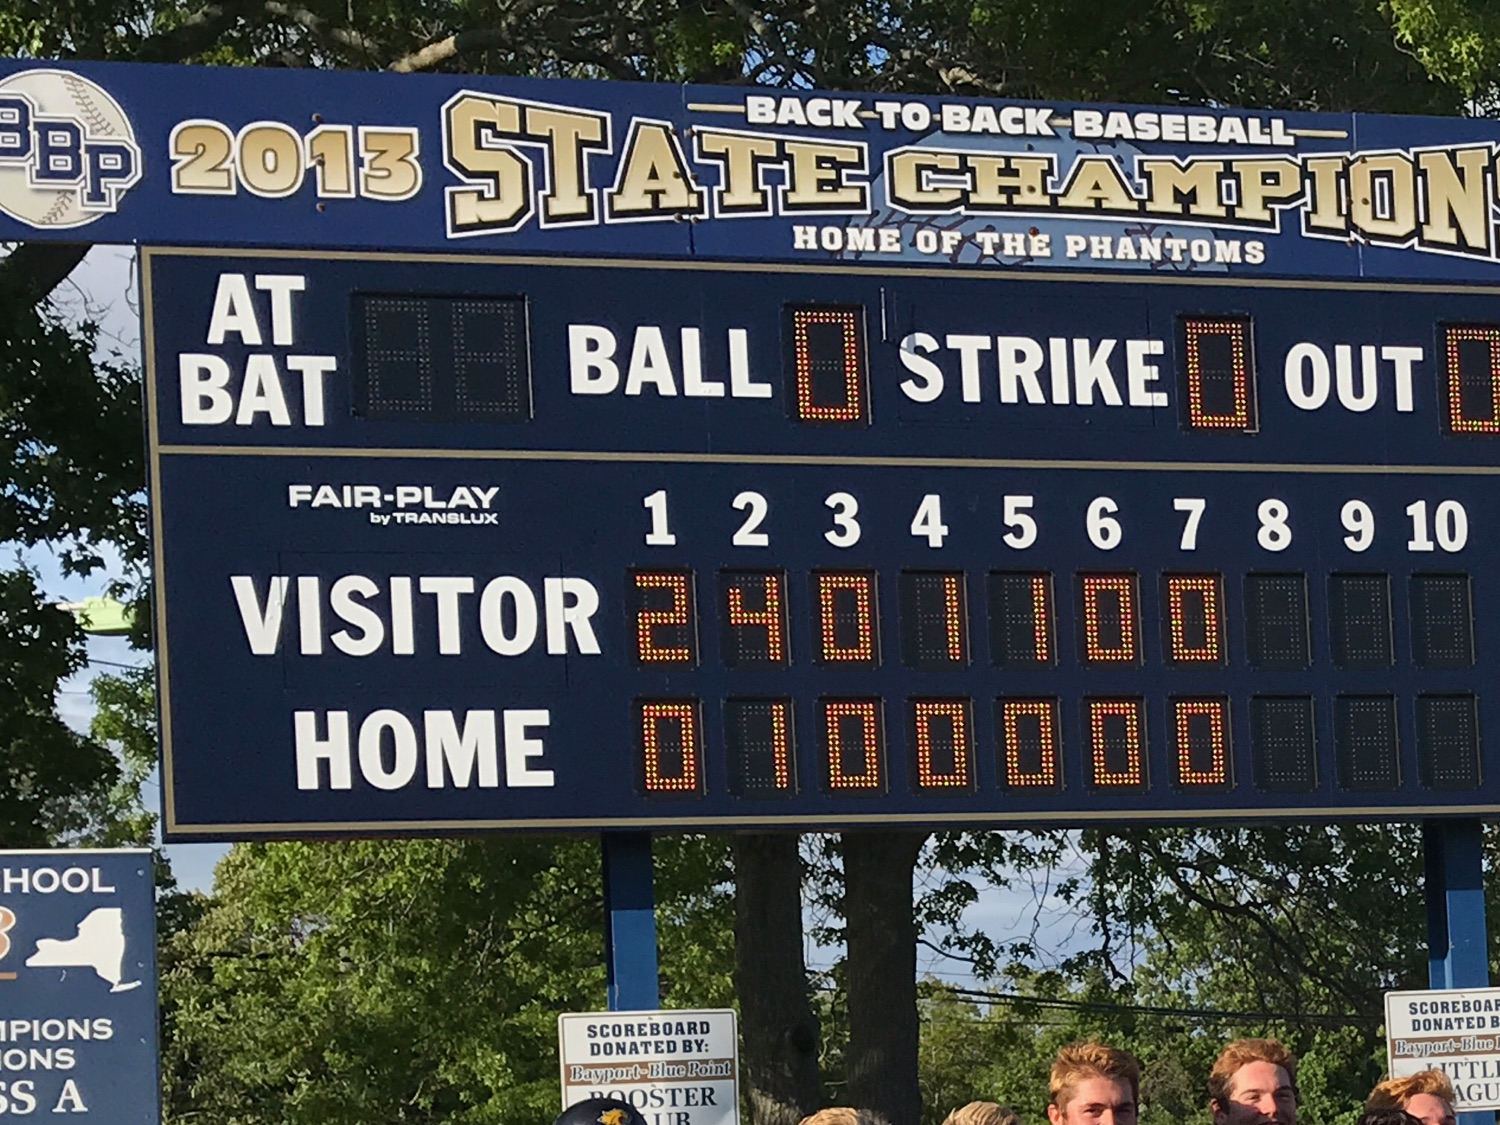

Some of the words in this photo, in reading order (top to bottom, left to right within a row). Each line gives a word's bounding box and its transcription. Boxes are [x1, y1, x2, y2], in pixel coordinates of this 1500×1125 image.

[747, 96, 863, 128] BACK
[876, 101, 923, 132] TO
[942, 105, 1052, 136] BACK
[1074, 111, 1294, 146] BASEBALL
[169, 120, 422, 200] 2013
[441, 90, 870, 239] STATE
[793, 225, 901, 253] HOME
[916, 229, 960, 255] OF
[975, 231, 1051, 258] THE
[1065, 234, 1266, 265] PHANTOMS
[206, 273, 305, 345] AT
[567, 325, 773, 399] BALL
[793, 310, 861, 421] 0
[899, 332, 1168, 408] STRIKE
[1185, 320, 1248, 429] 0
[1284, 342, 1424, 413] OUT
[179, 353, 337, 426] BAT
[288, 485, 500, 510] FAIR-PLAY
[392, 511, 499, 526] TRANSLUX
[643, 490, 677, 545] 1
[731, 491, 769, 547] 2
[823, 491, 861, 548] 3
[910, 494, 949, 548] 4
[1002, 495, 1037, 549] 5
[1086, 496, 1122, 550] 6
[1173, 498, 1206, 550] 7
[1256, 498, 1292, 552] 8
[1340, 499, 1375, 553] 9
[1406, 500, 1469, 553] 10
[230, 575, 601, 656] VISITOR
[634, 574, 690, 662] 2
[727, 576, 782, 663] 4
[819, 576, 873, 662] 0
[944, 576, 961, 661] 1
[1031, 577, 1048, 661] 1
[1083, 577, 1135, 662] 0
[1168, 577, 1220, 661] 0
[293, 708, 555, 791] HOME
[640, 703, 697, 790] 0
[770, 703, 788, 790] 1
[825, 702, 877, 789] 0
[915, 702, 967, 788] 0
[1004, 702, 1055, 786] 0
[1089, 702, 1141, 785] 0
[1175, 701, 1227, 784] 0
[0, 867, 116, 894] HOOL
[0, 1018, 113, 1042] PIONS
[587, 1021, 710, 1039] SCOREBOARD
[1412, 1017, 1486, 1032] DONATED
[0, 1048, 76, 1071] ONS
[590, 1040, 677, 1056] DONATED
[683, 1039, 709, 1053] BY:
[688, 1060, 731, 1077] Point
[52, 1079, 88, 1112] A
